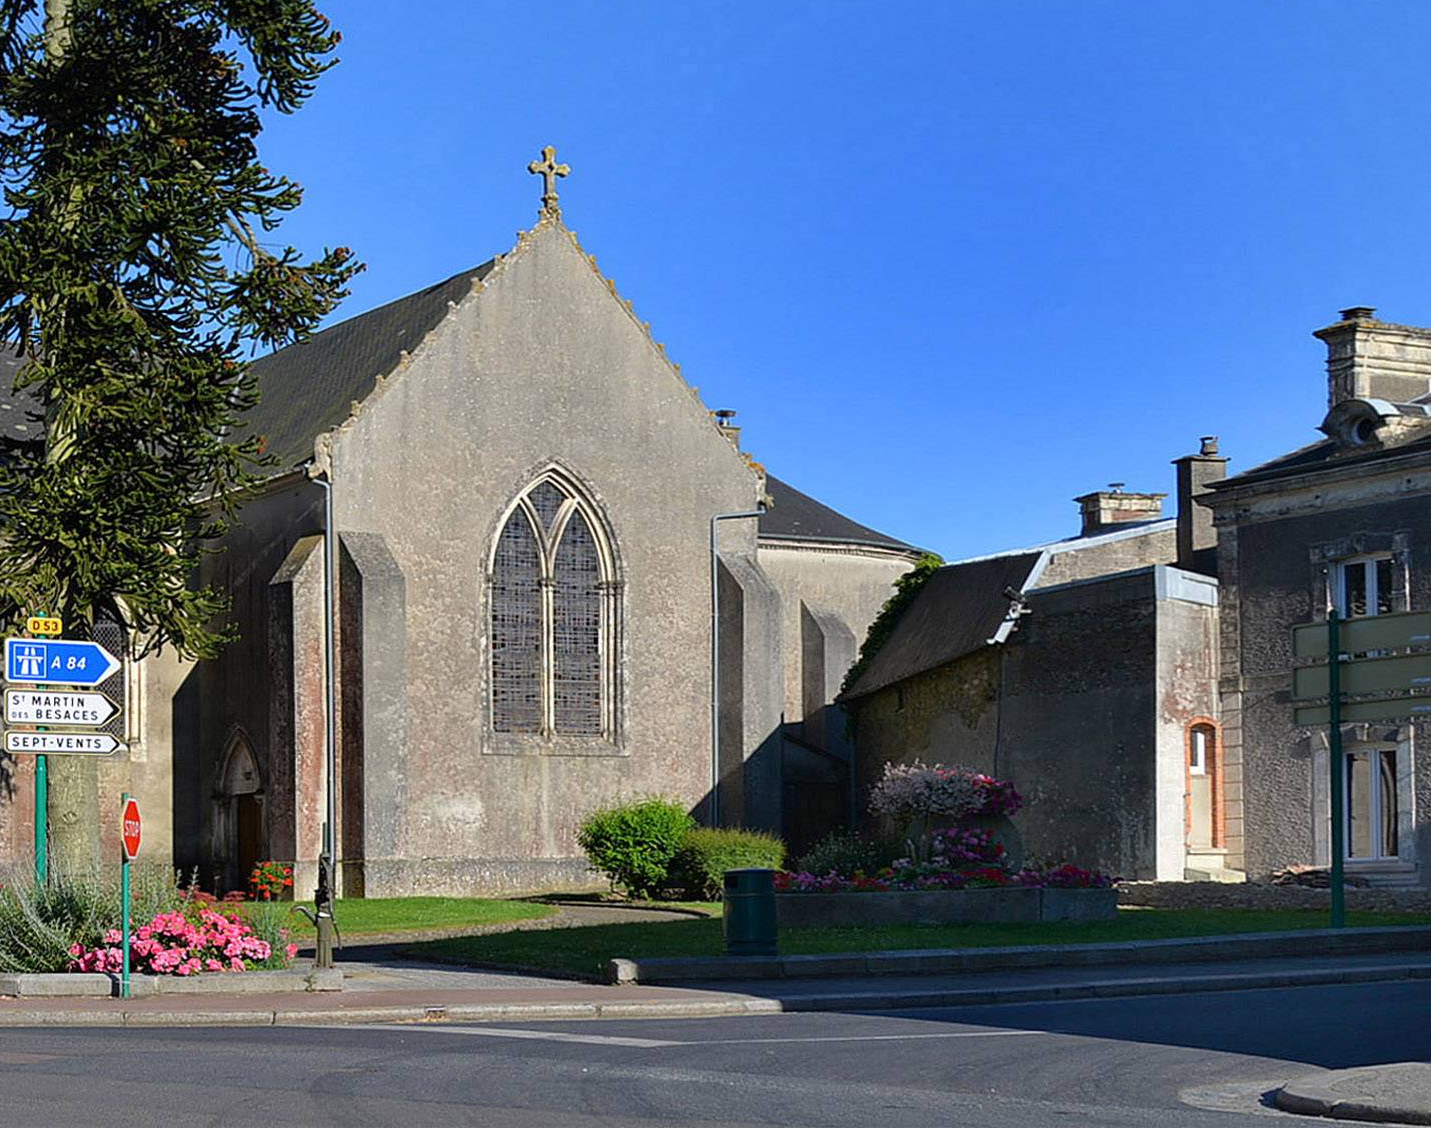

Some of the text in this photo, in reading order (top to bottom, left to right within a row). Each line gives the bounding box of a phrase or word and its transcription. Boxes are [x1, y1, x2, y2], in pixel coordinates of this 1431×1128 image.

[32, 622, 58, 632] D 53
[50, 655, 86, 670] A 84
[31, 695, 85, 707] MARTIN
[11, 709, 98, 721] DES BESACES
[12, 736, 102, 750] SEPT-VENTS
